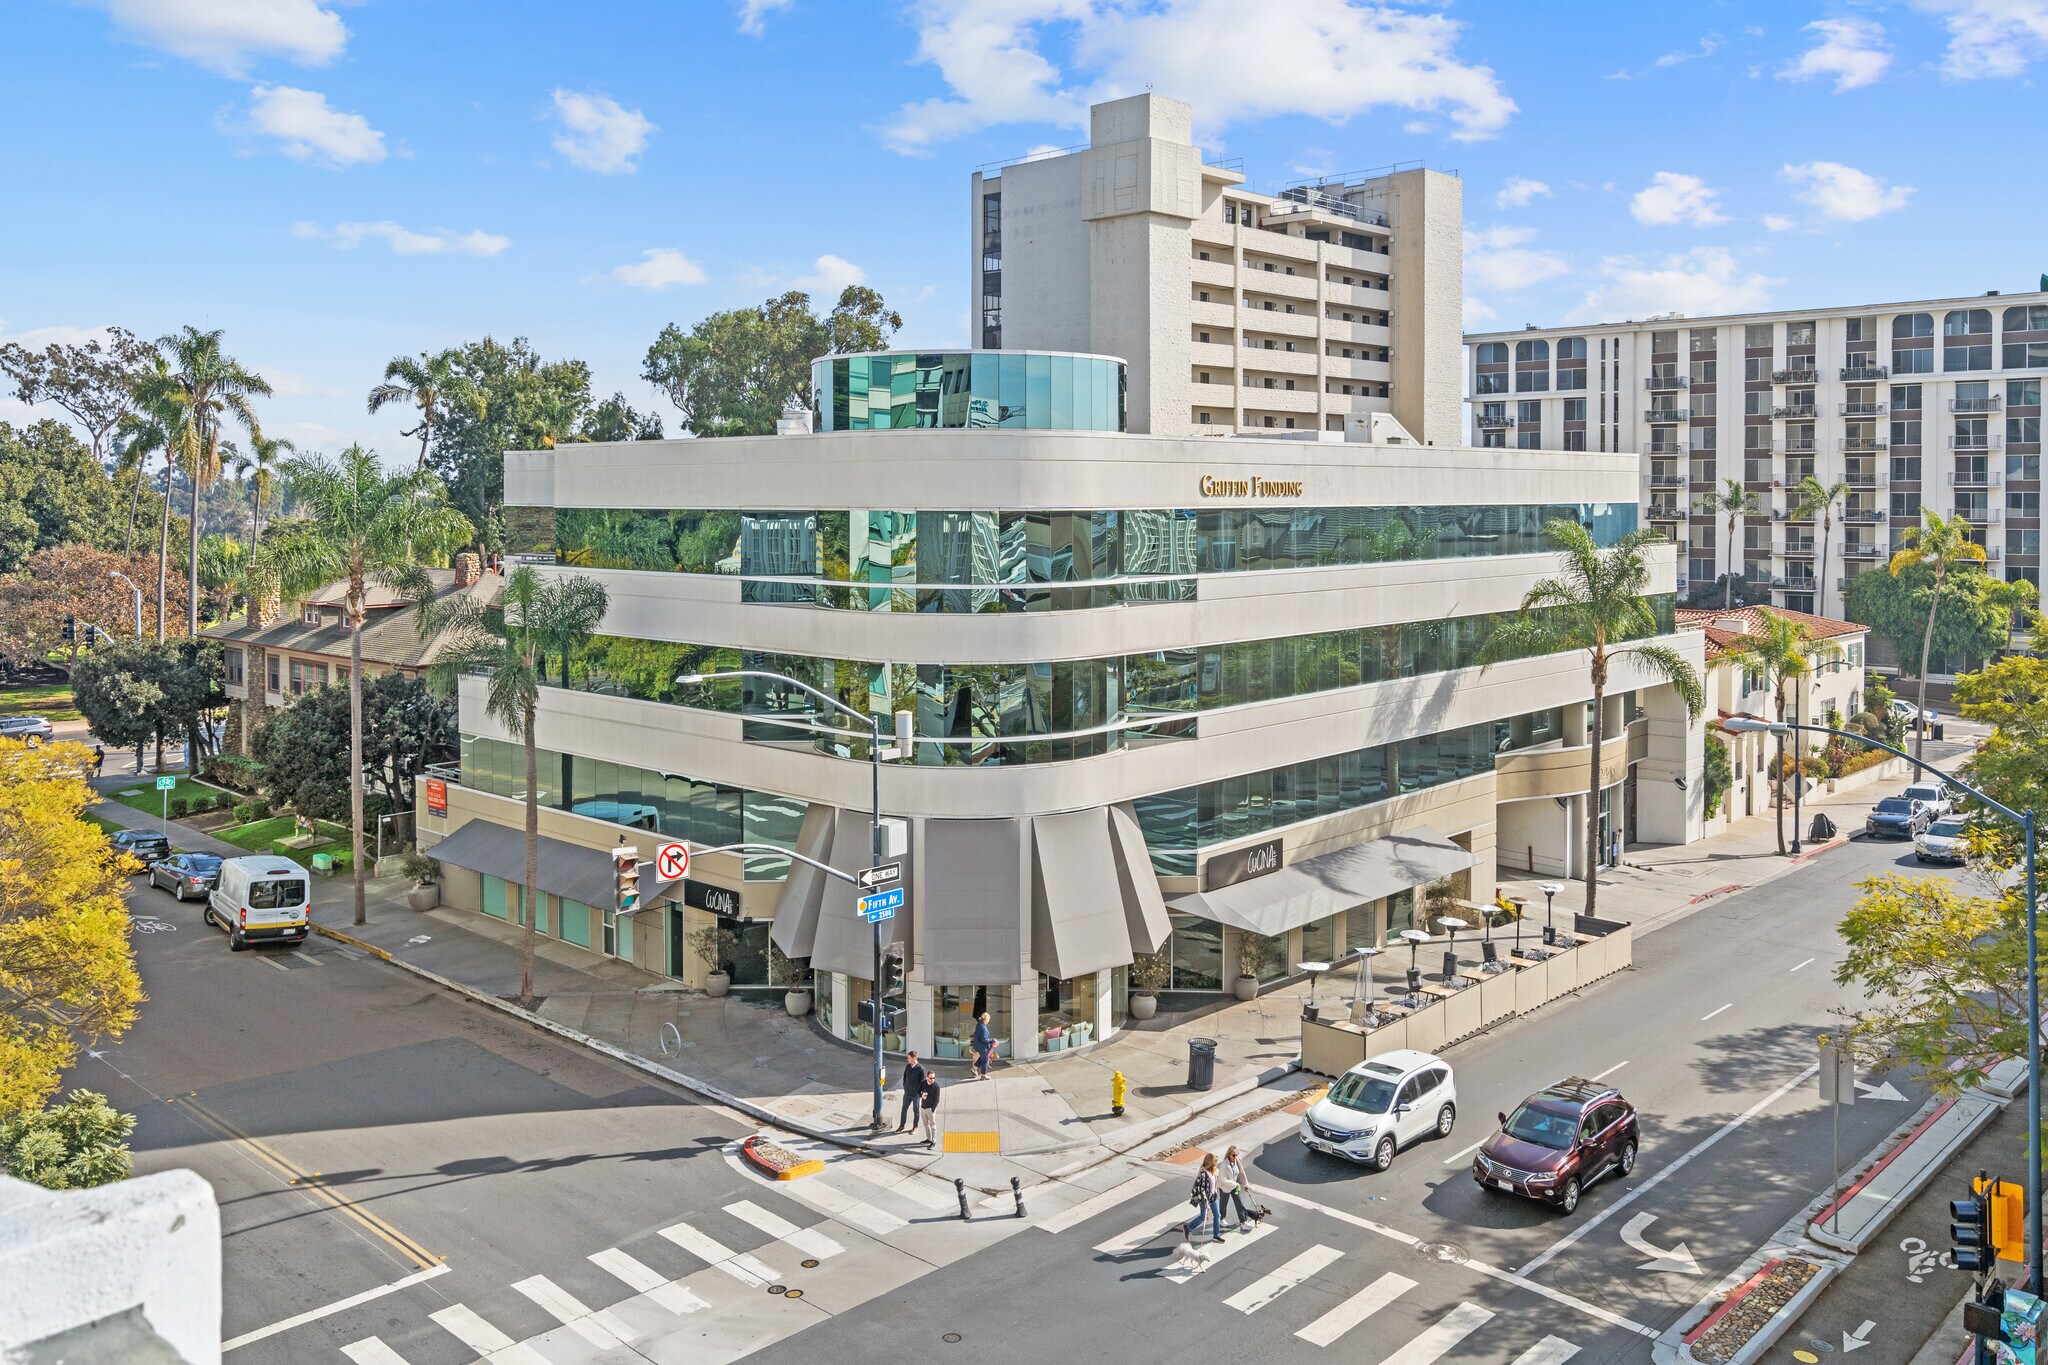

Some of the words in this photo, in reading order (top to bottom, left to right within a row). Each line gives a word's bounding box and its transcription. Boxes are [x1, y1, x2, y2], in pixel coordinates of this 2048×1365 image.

[1200, 473, 1249, 496] GRIFFIN
[1251, 475, 1304, 497] FUNDING
[871, 871, 883, 881] ONE
[885, 868, 897, 878] WAY
[868, 898, 887, 911] FIFTH
